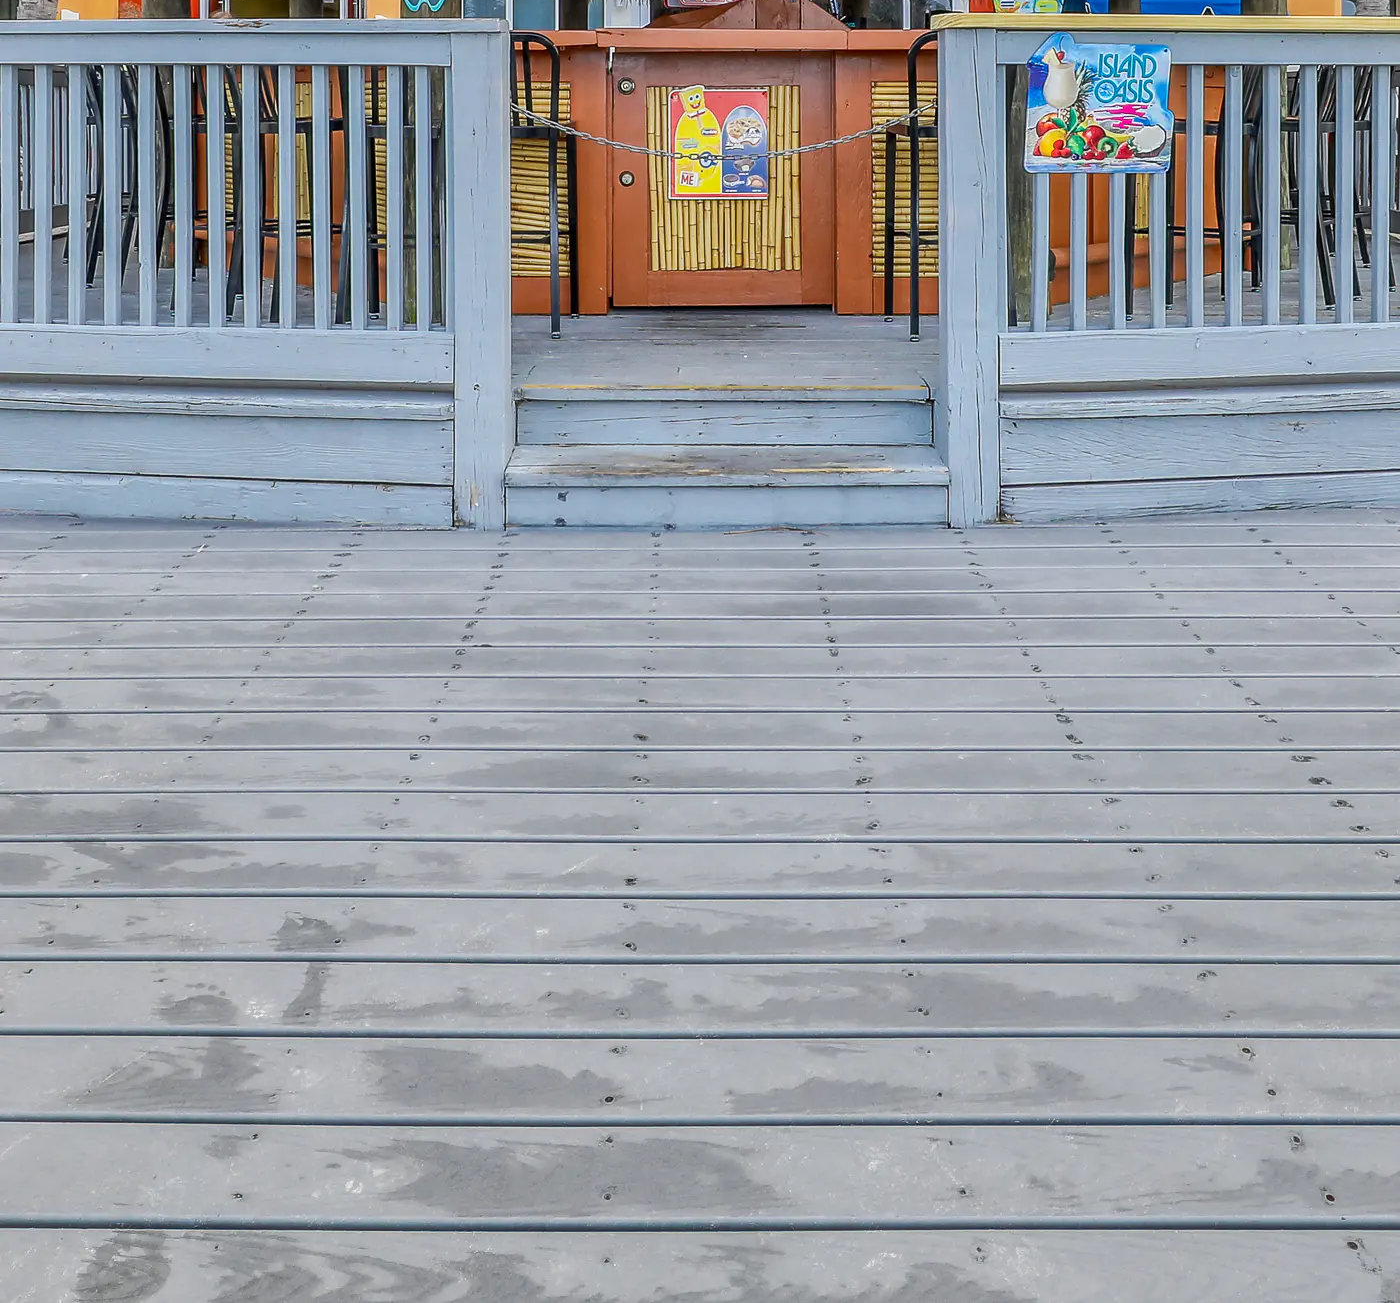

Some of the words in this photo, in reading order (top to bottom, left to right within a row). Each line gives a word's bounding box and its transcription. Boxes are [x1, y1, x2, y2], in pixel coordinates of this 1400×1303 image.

[1098, 53, 1158, 79] ISLAND
[1093, 79, 1155, 104] OASIS
[680, 173, 694, 186] ME
